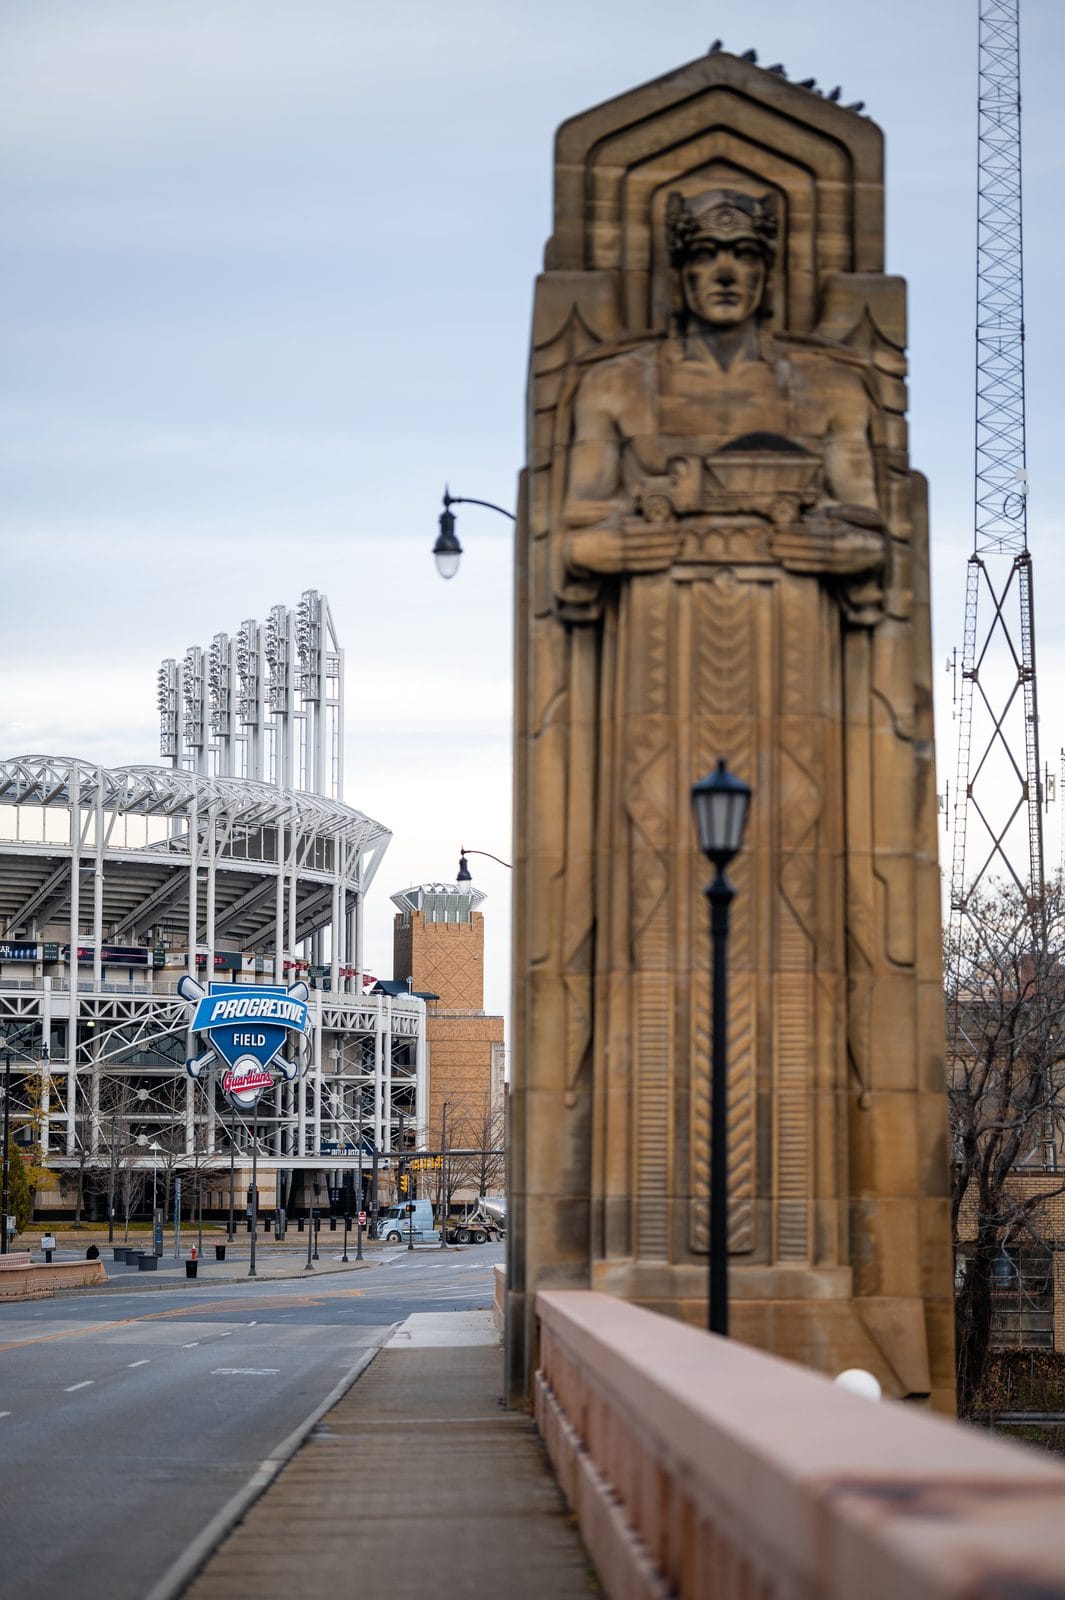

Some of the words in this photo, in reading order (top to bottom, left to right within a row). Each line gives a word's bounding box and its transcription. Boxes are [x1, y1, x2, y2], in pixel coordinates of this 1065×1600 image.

[211, 998, 305, 1024] PROGRESSIVE
[233, 1033, 266, 1046] FIELD
[223, 1068, 274, 1093] Guardians
